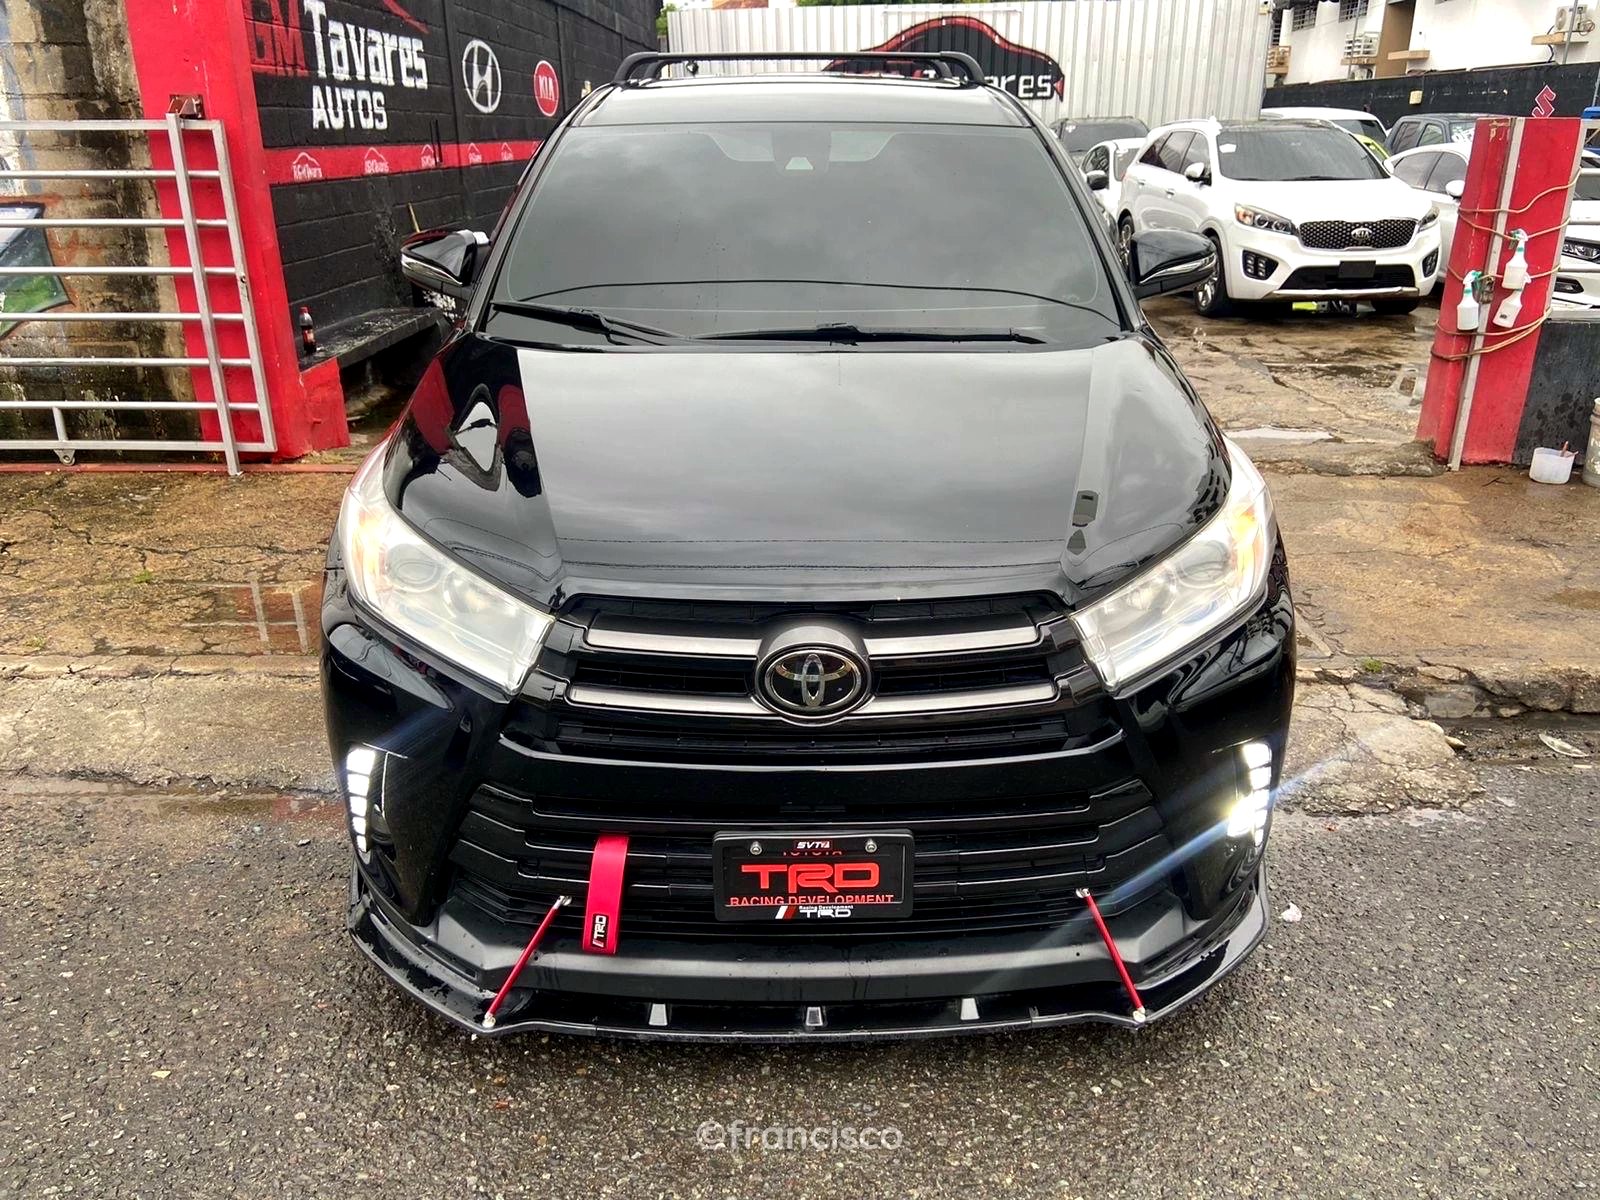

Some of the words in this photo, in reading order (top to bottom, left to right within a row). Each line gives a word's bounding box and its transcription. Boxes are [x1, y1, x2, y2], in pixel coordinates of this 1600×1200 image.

[304, 0, 428, 89] Tavares
[538, 75, 555, 101] KIA
[312, 85, 388, 130] AUTOS
[741, 862, 880, 893] TRD
[730, 896, 784, 906] RACING
[788, 894, 894, 905] DEVELOPMENT
[799, 908, 852, 918] TRD
[594, 915, 607, 939] TRD
